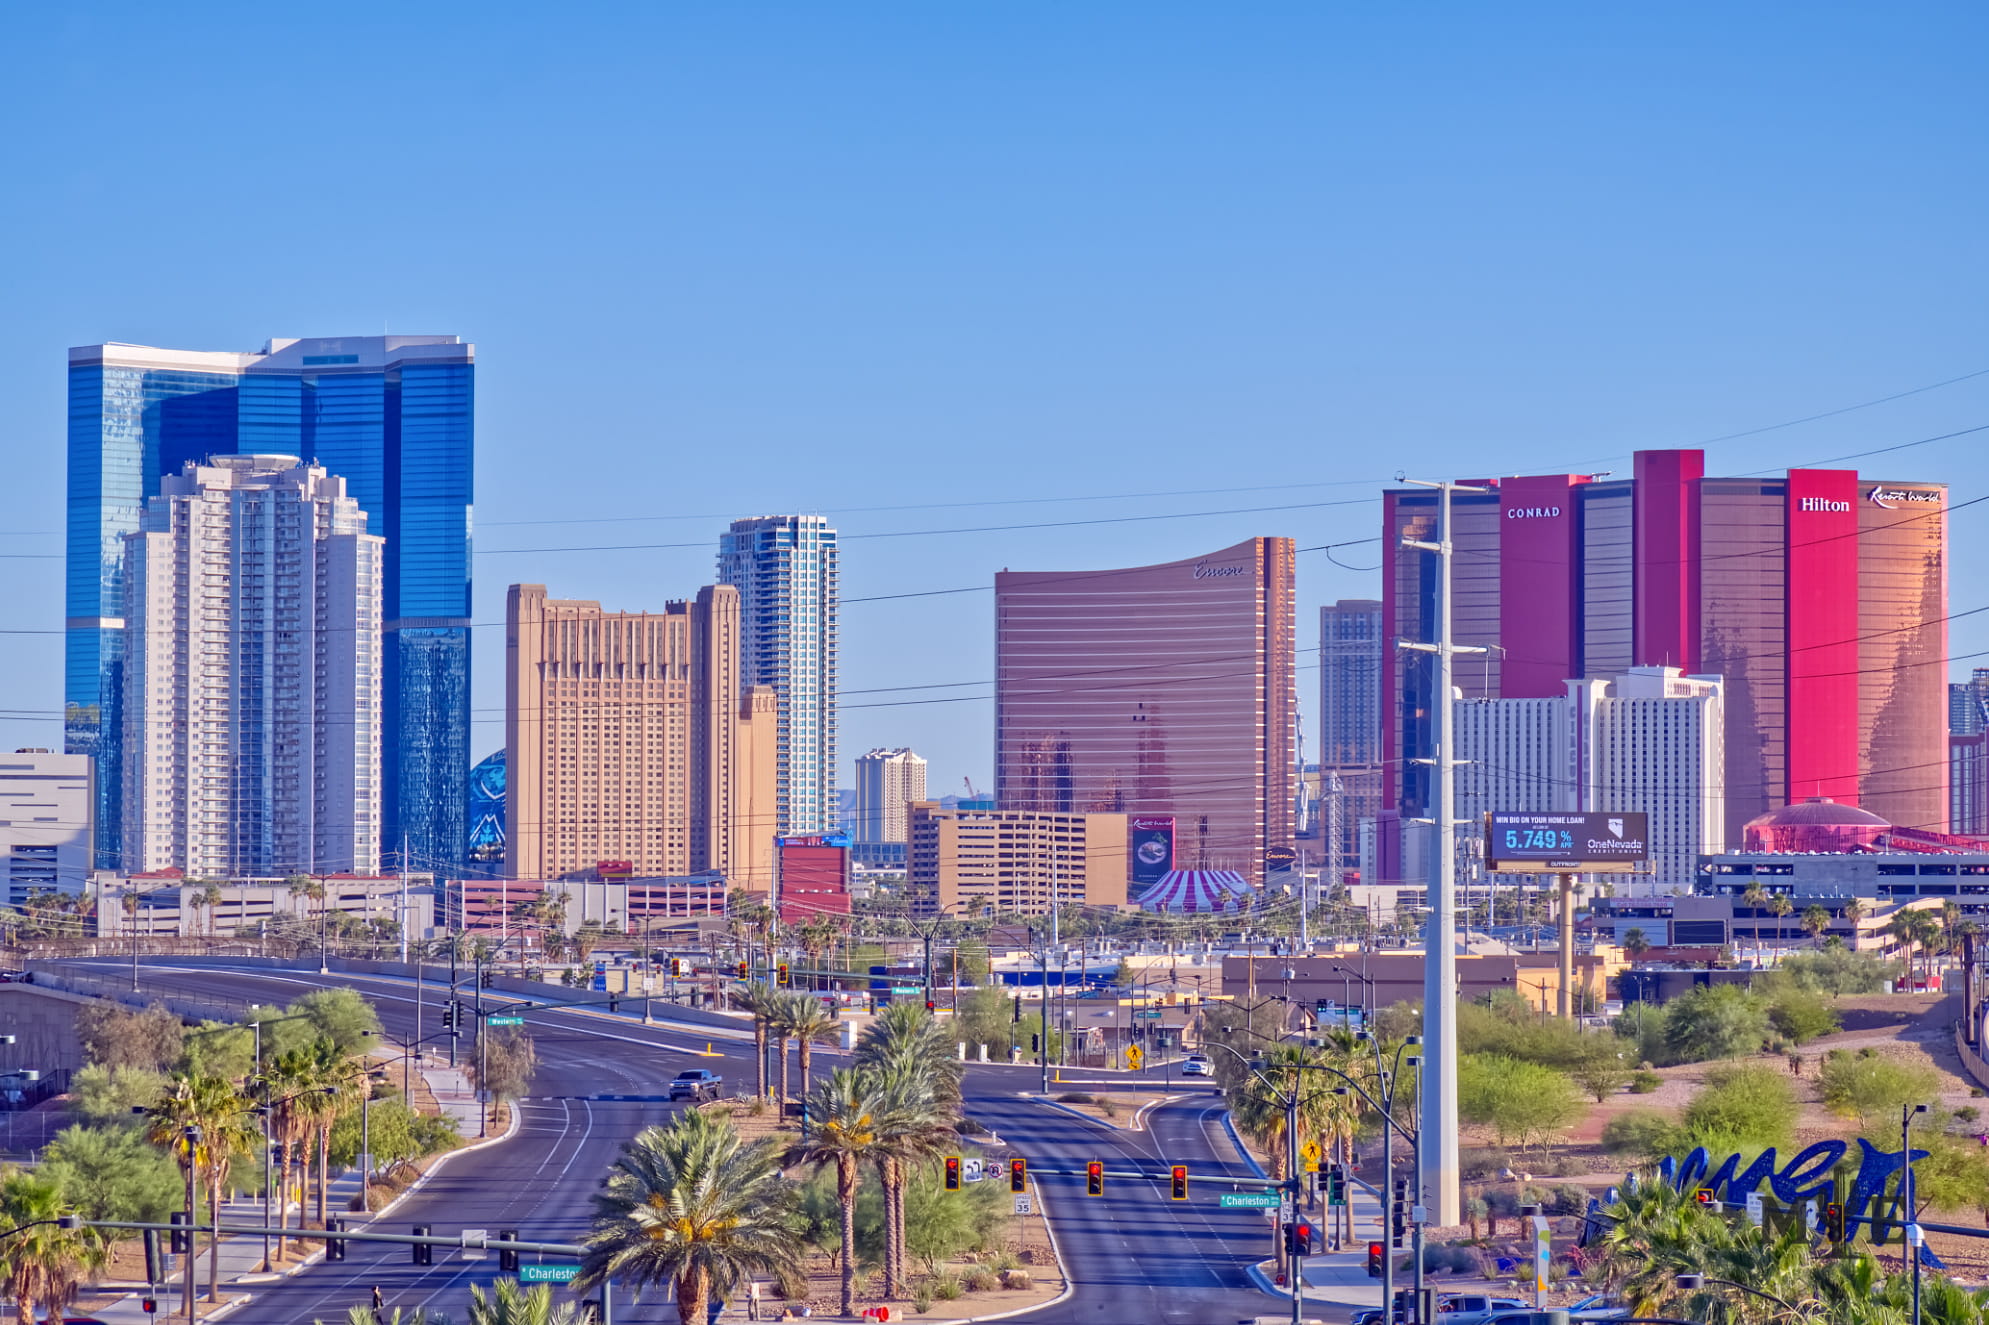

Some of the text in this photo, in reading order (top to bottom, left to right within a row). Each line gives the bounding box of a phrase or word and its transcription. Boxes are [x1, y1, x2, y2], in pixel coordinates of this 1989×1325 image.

[1802, 497, 1850, 512] Hilton
[1507, 506, 1560, 519] CONRAD
[1193, 560, 1244, 580] Encore
[1496, 816, 1508, 824] WIN
[1509, 816, 1520, 824] BIG
[1521, 816, 1530, 824] ON
[1530, 816, 1547, 824] YOUR
[1547, 816, 1566, 824] HOME
[1506, 830, 1572, 849] 5.749 %
[1587, 839, 1642, 849] OneNevada
[1226, 1195, 1270, 1206] Charleston
[1017, 1204, 1029, 1213] 35
